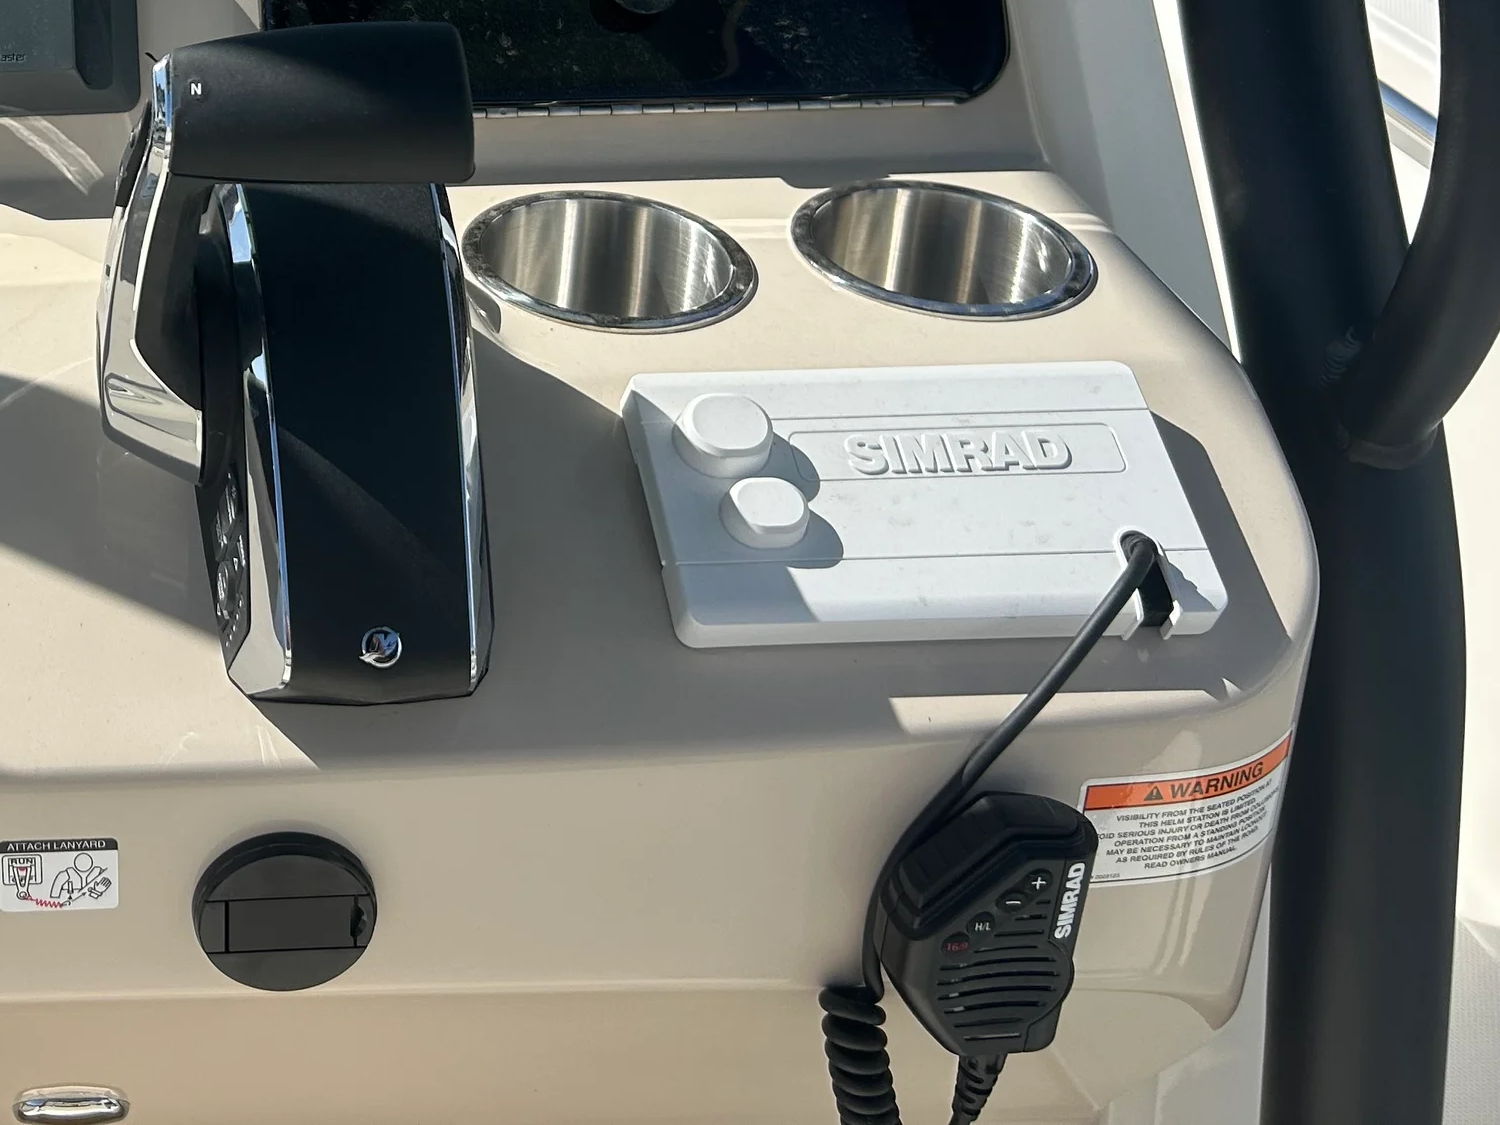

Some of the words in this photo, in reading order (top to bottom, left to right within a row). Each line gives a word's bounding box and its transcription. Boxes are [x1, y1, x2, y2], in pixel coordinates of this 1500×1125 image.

[190, 82, 202, 95] N
[844, 429, 1073, 475] SIMRAD
[1170, 761, 1264, 799] WARNING
[1116, 812, 1160, 822] VISIBILITY
[1161, 809, 1187, 818] FROM
[1189, 806, 1205, 814] THE
[1207, 800, 1236, 812] SEATED
[1160, 818, 1185, 827] HELM
[1187, 812, 1220, 823] STATION
[1114, 837, 1165, 847] OPERATION
[1166, 834, 1191, 843] FROM
[1199, 821, 1238, 837] STANDING
[1117, 828, 1156, 839] SERIOUS
[1158, 825, 1190, 835] INJURY
[1190, 823, 1202, 832] OR
[1204, 816, 1229, 828] DEATH
[7, 842, 51, 852] ATTACH
[54, 840, 106, 850] LANYARD
[1106, 847, 1125, 856] MAY
[1126, 846, 1139, 854] BE
[1141, 841, 1192, 853] NECESSARY
[1193, 838, 1205, 846] TO
[1206, 830, 1236, 845] MAINTAIN
[1115, 856, 1128, 864] AS
[1130, 852, 1175, 863] REQUIRED
[1176, 850, 1188, 858] BY
[1189, 845, 1214, 856] RULES
[1215, 841, 1227, 850] OF
[1227, 837, 1240, 847] THE
[10, 857, 33, 865] RUN
[1144, 860, 1168, 870] READ
[1169, 855, 1205, 865] OWNERS
[1054, 862, 1086, 939] SIMRAD
